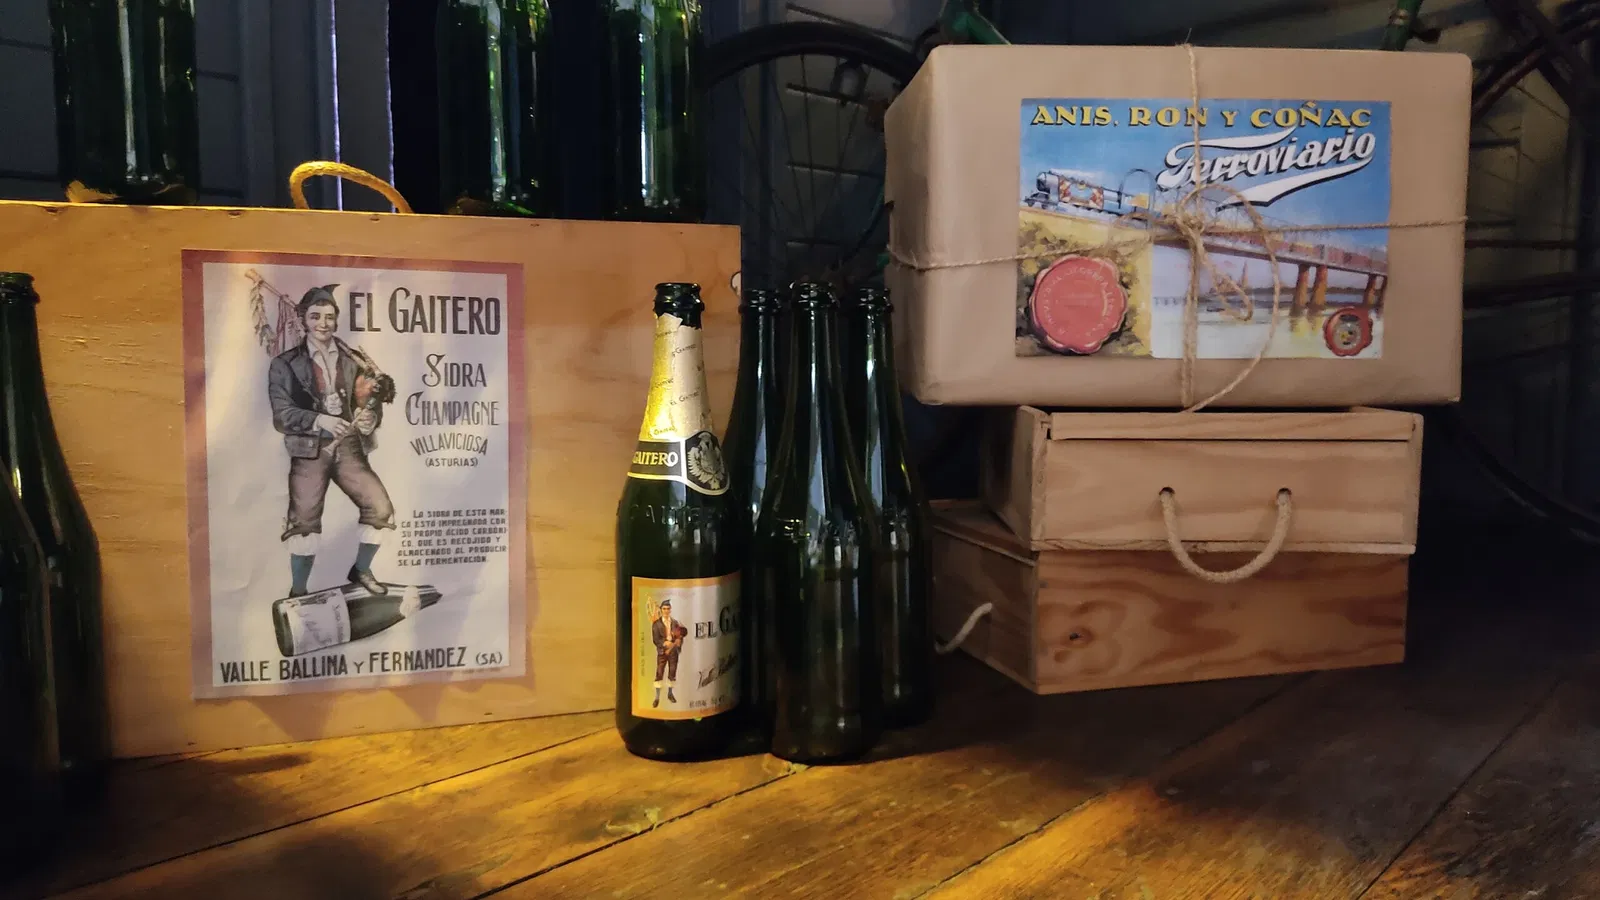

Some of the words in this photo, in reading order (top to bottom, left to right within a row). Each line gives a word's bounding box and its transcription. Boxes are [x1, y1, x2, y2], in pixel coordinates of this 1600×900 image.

[1031, 105, 1119, 127] ANIS.
[1128, 106, 1208, 127] RON
[1221, 110, 1237, 127] Y
[1250, 100, 1373, 128] COÑAC
[1155, 126, 1377, 192] Ferroviario
[349, 291, 381, 332] EL
[388, 286, 501, 335] GAITERO
[422, 353, 487, 387] SIDRA
[405, 391, 500, 426] CHAMPAGNE
[410, 432, 489, 456] VILLAVICIOSA
[425, 457, 478, 468] (ASTURIAS)
[427, 510, 451, 518] SIDRA
[452, 509, 463, 517] DE
[465, 509, 487, 517] ESTA
[438, 518, 488, 527] IMPREGNADA
[401, 530, 412, 538] SU
[414, 529, 443, 537] PROPIO
[417, 539, 433, 547] QUE
[436, 538, 448, 546] ES
[450, 536, 492, 545] RECOJIDO
[397, 548, 452, 557] ALMACENADO
[468, 545, 507, 553] PRODUCIR
[397, 559, 408, 567] SE
[694, 621, 717, 639] EL
[220, 660, 271, 683] VALLE
[279, 654, 348, 681] BALLINA
[369, 646, 467, 673] FERNANDEZ
[475, 652, 503, 666] (SA)
